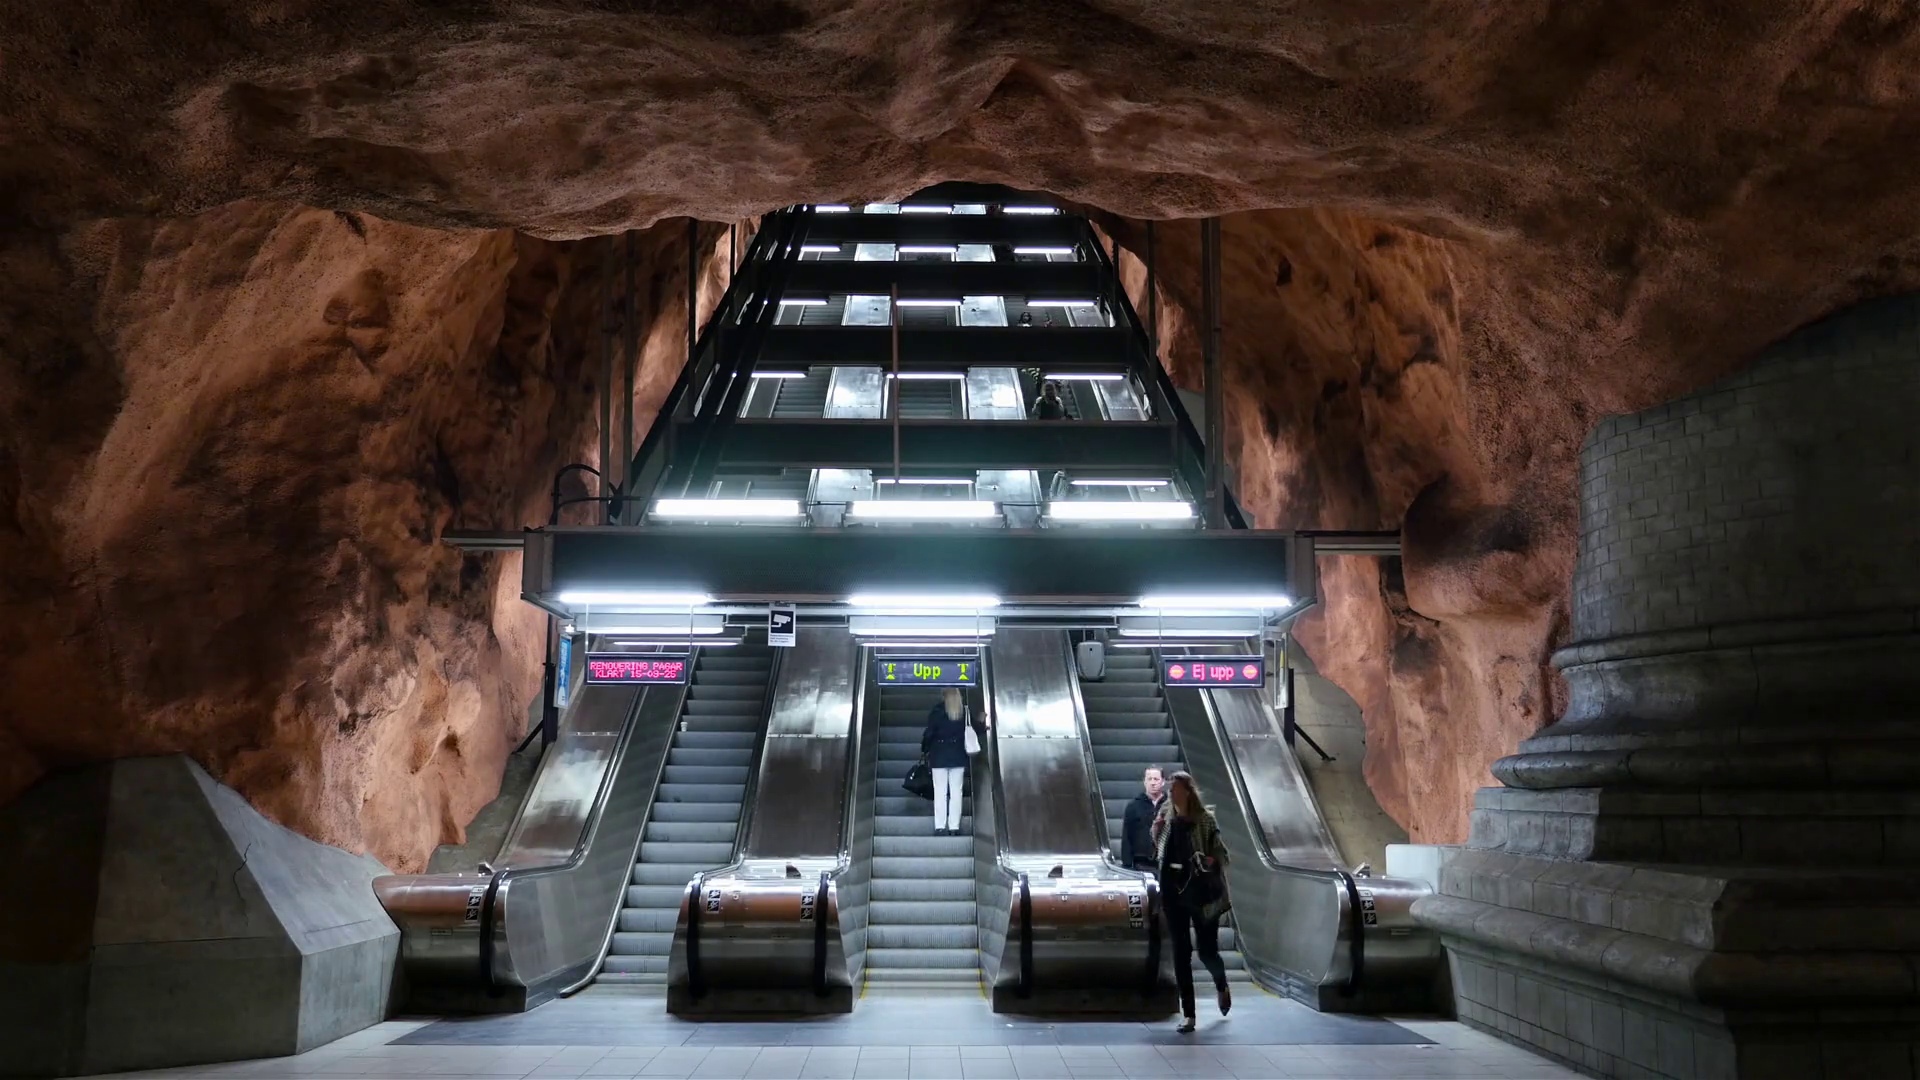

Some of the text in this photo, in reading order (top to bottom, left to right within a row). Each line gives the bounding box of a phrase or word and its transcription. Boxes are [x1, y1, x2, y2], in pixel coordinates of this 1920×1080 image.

[595, 669, 625, 678] KLART
[913, 663, 942, 680] Upp
[1192, 663, 1235, 681] Ej upp
